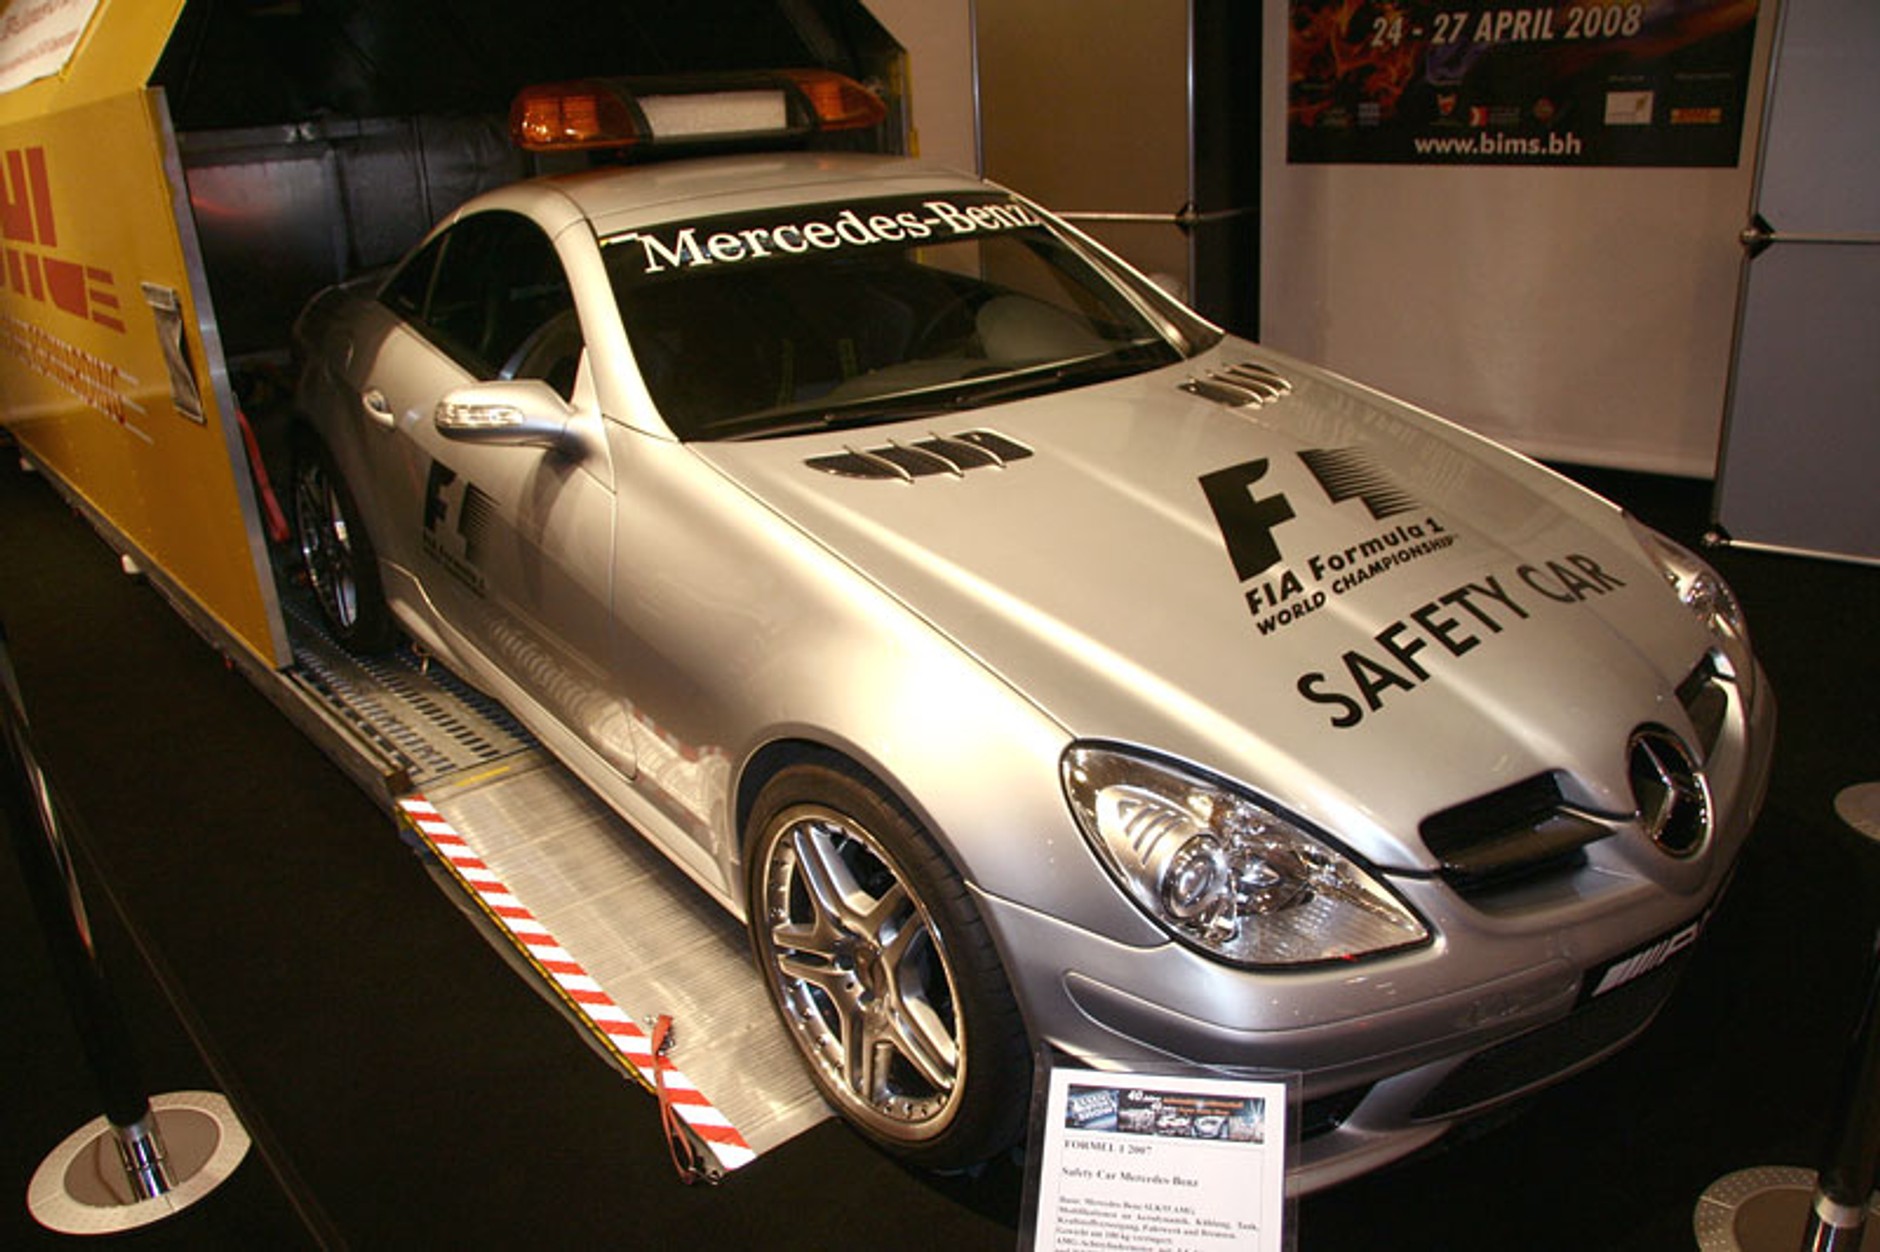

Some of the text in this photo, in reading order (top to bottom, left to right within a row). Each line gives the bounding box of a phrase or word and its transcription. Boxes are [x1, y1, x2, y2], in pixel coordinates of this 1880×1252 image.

[1371, 16, 1402, 47] 24
[1431, 12, 1469, 43] 27
[1473, 9, 1555, 42] APRIL
[1564, 3, 1643, 40] 2008
[1414, 131, 1582, 155] www.bims.bh
[636, 199, 1040, 274] Mercedes-Benz
[1198, 445, 1425, 583] F1
[1244, 516, 1445, 617] FIA Formula 1
[1255, 535, 1457, 637] WORLD CHAMPIONSHIP
[1297, 553, 1627, 729] SAFETY CAR
[1062, 1166, 1093, 1180] Safety
[1097, 1169, 1118, 1181] Car
